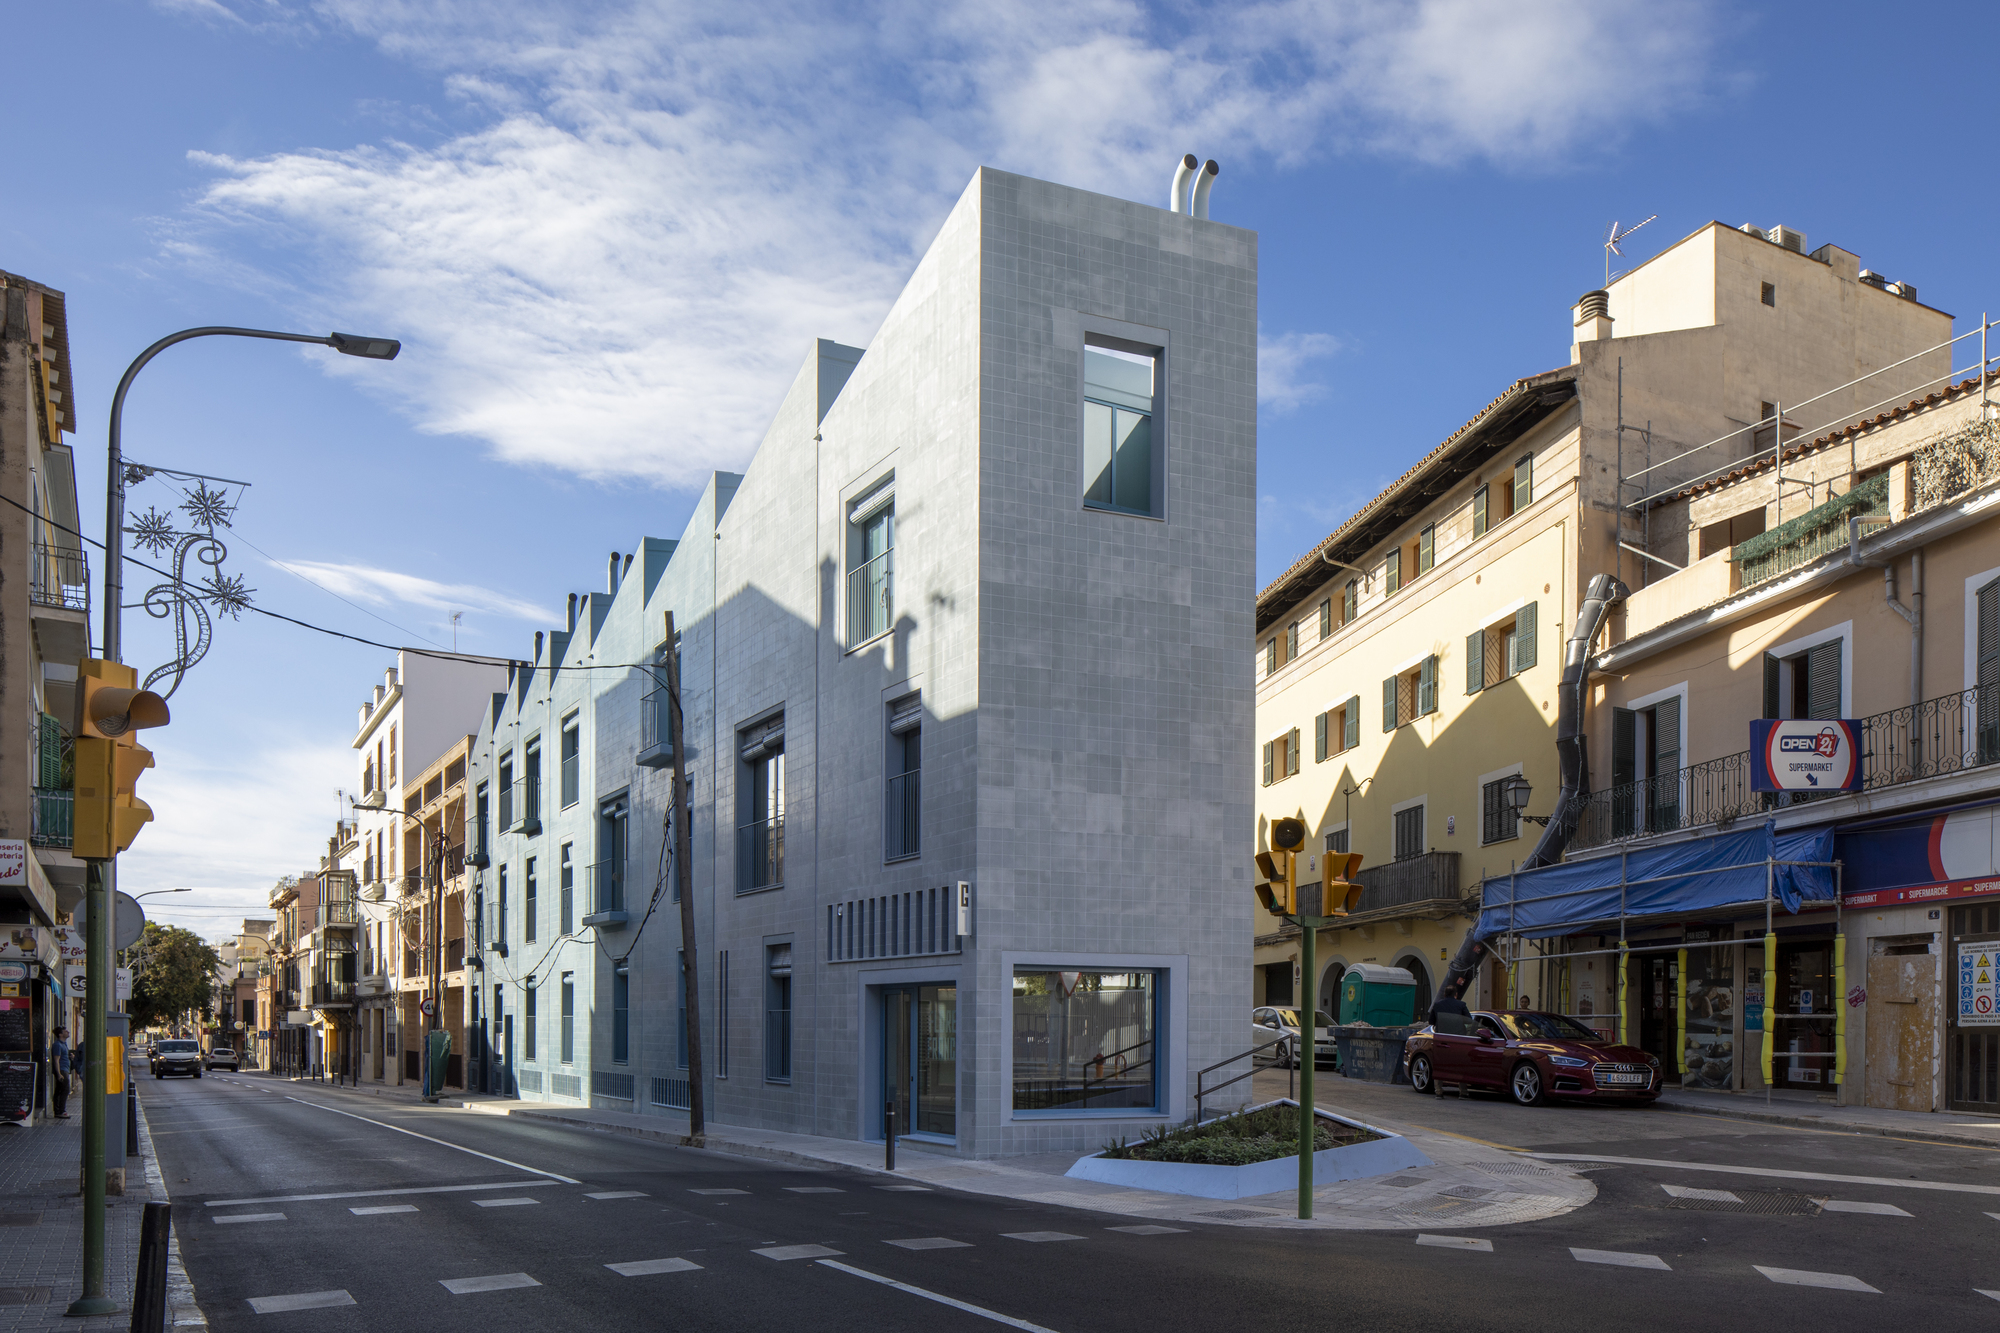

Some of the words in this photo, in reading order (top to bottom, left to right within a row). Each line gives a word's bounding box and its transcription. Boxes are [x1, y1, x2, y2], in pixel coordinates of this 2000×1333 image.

[1781, 738, 1816, 749] OPEN
[1819, 736, 1833, 755] 24
[1788, 762, 1833, 772] SUPERMARKET
[1908, 885, 1949, 899] SUPERMARCHÉ
[1844, 893, 1878, 906] SUPERMARKT
[1629, 1074, 1641, 1082] LFF
